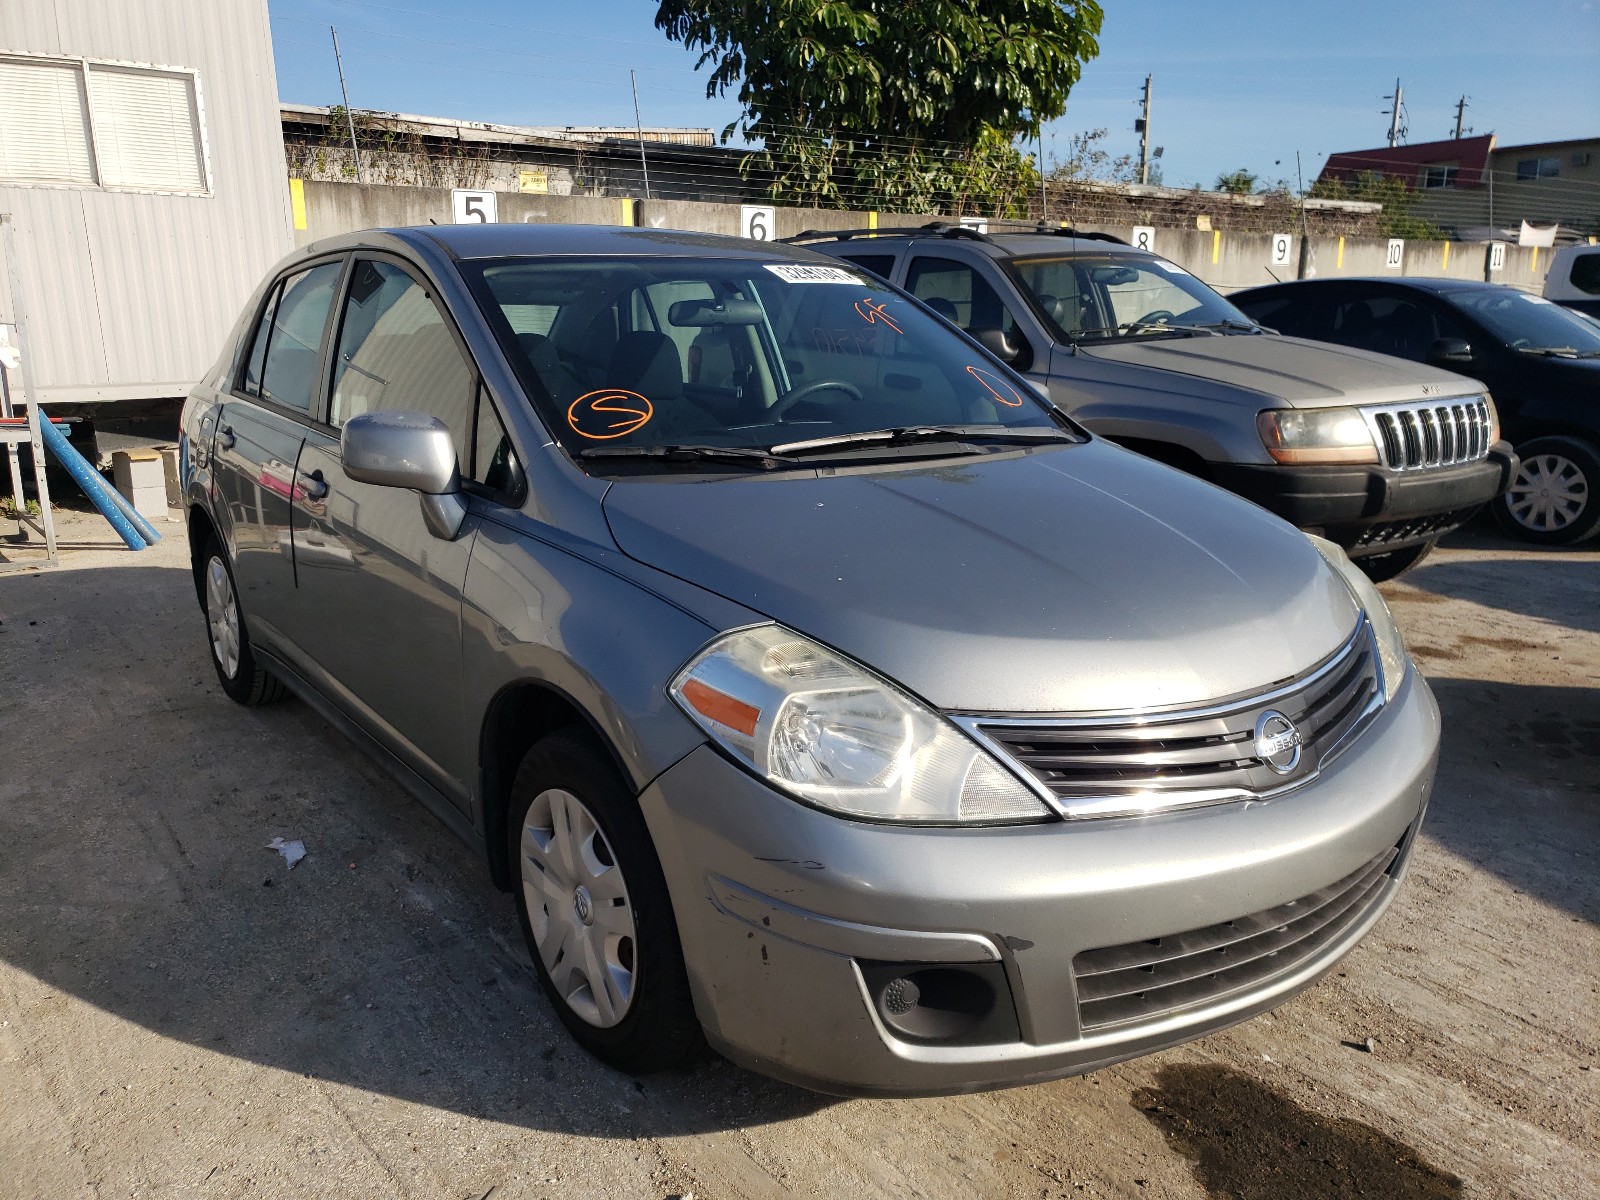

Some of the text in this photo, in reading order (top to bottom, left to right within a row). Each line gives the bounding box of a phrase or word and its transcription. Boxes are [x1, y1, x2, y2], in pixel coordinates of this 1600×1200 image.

[465, 196, 487, 223] 5
[750, 211, 767, 240] 6
[1138, 232, 1148, 251] 8
[1277, 239, 1286, 260] 9
[1389, 243, 1400, 263] 10
[1493, 247, 1501, 265] 11
